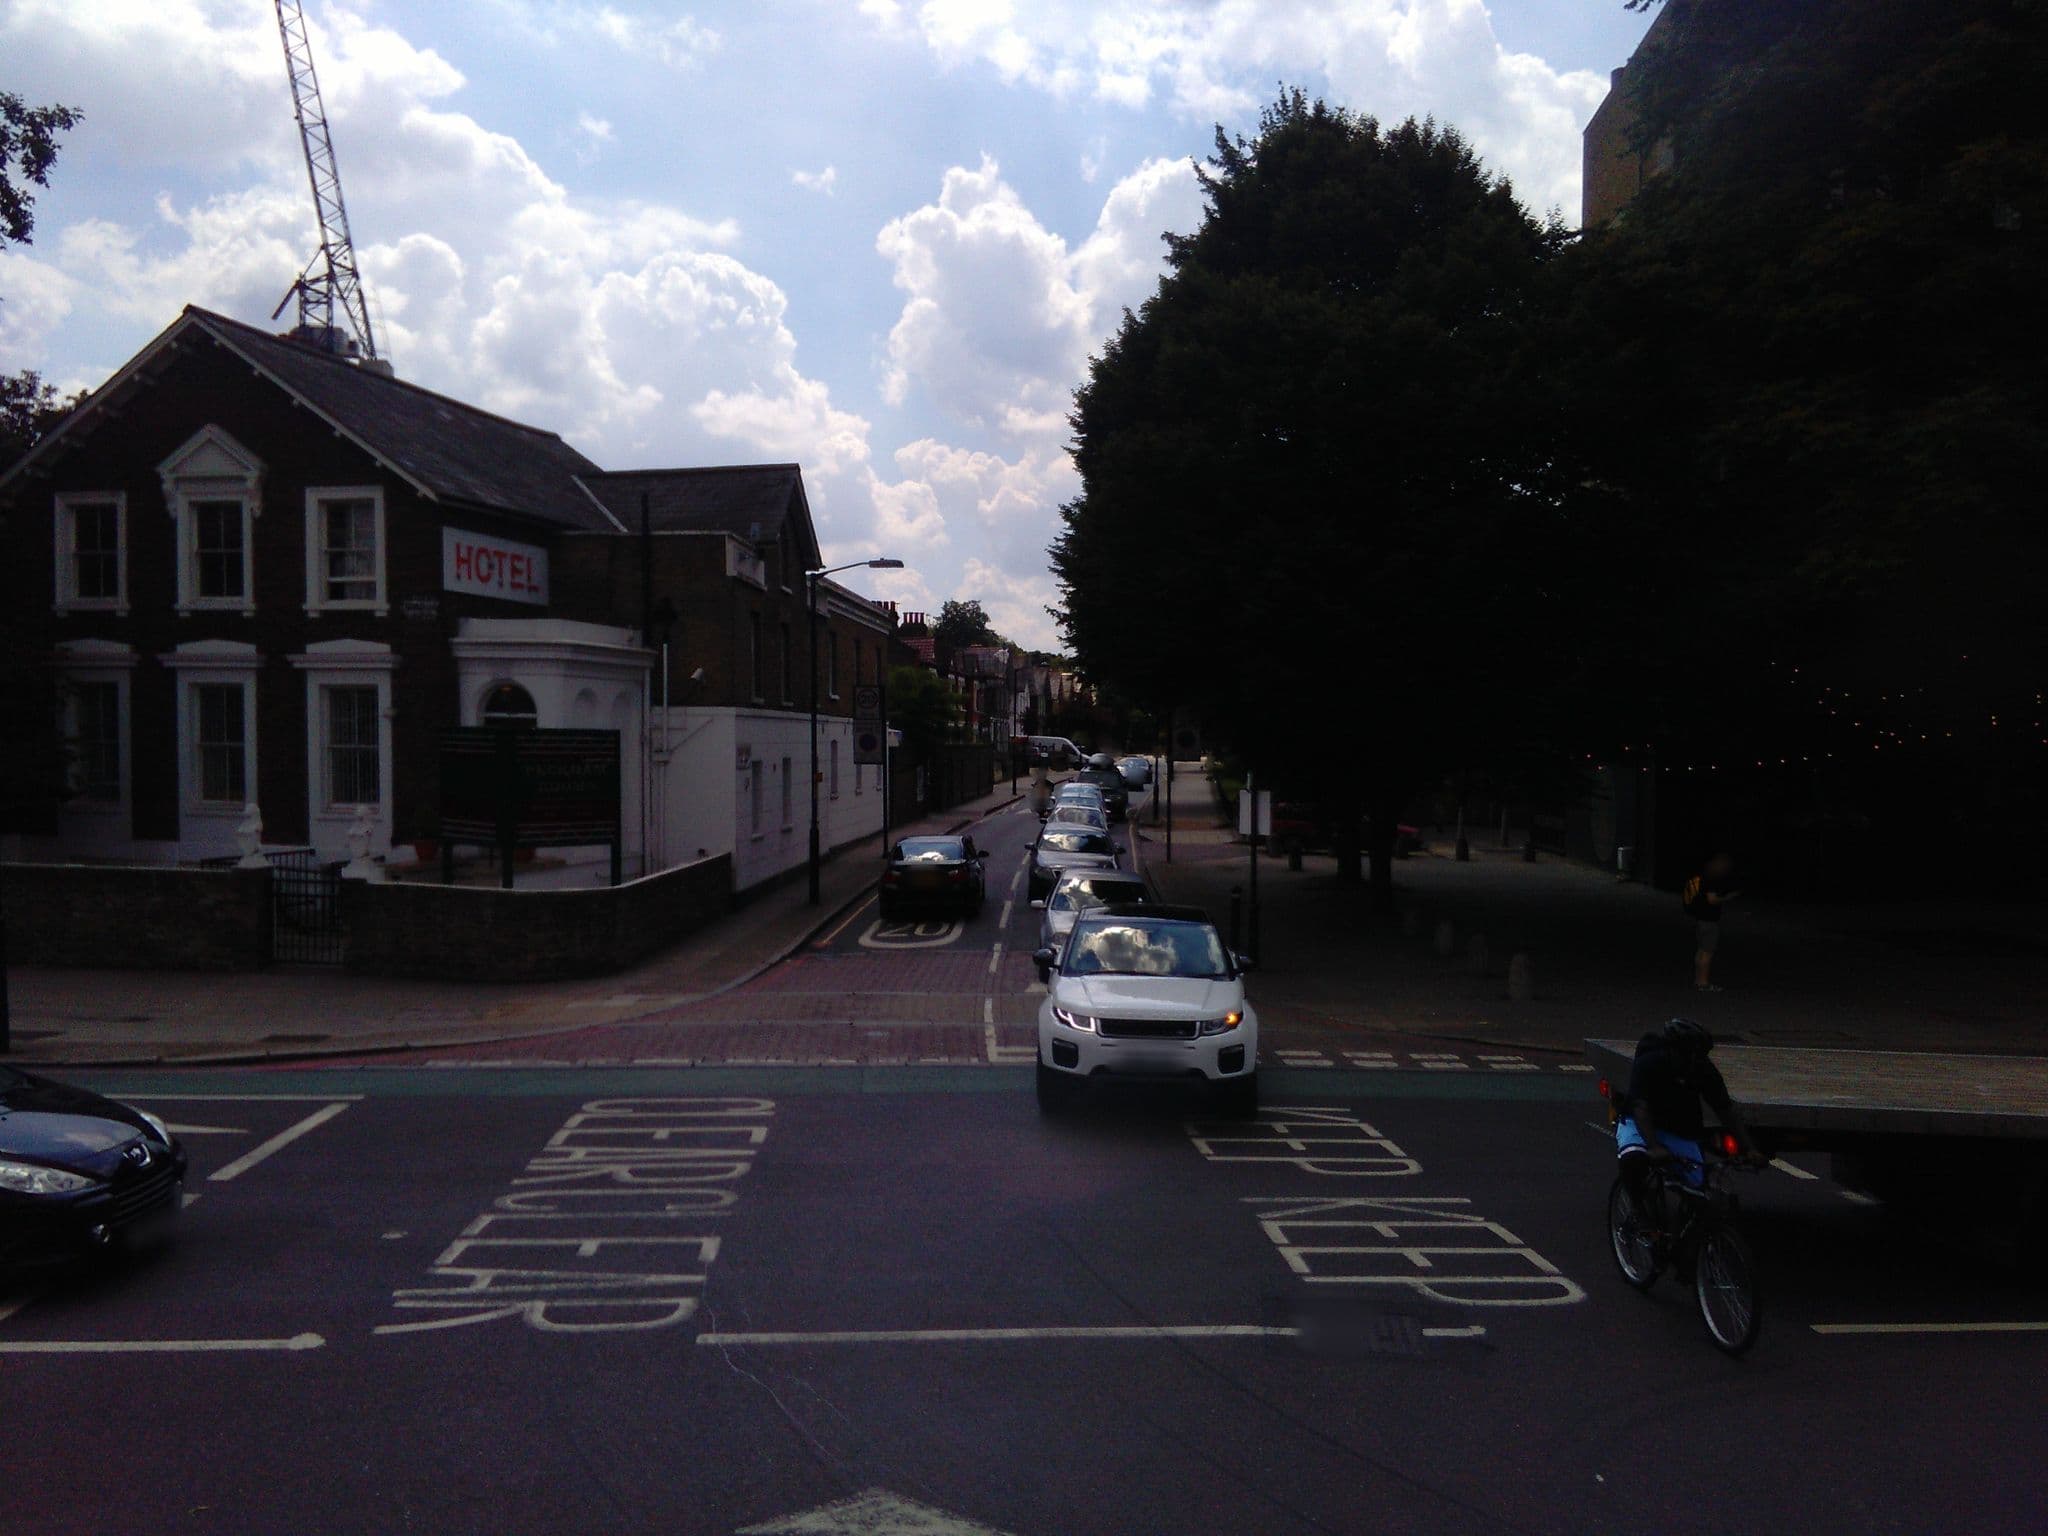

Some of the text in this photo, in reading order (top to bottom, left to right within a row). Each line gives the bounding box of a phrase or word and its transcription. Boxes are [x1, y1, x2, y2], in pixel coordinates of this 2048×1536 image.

[455, 543, 539, 592] HOTEL
[510, 1097, 776, 1185] CLEAR
[372, 1187, 739, 1334] CLEAR
[1238, 1197, 1588, 1307] KEEP
